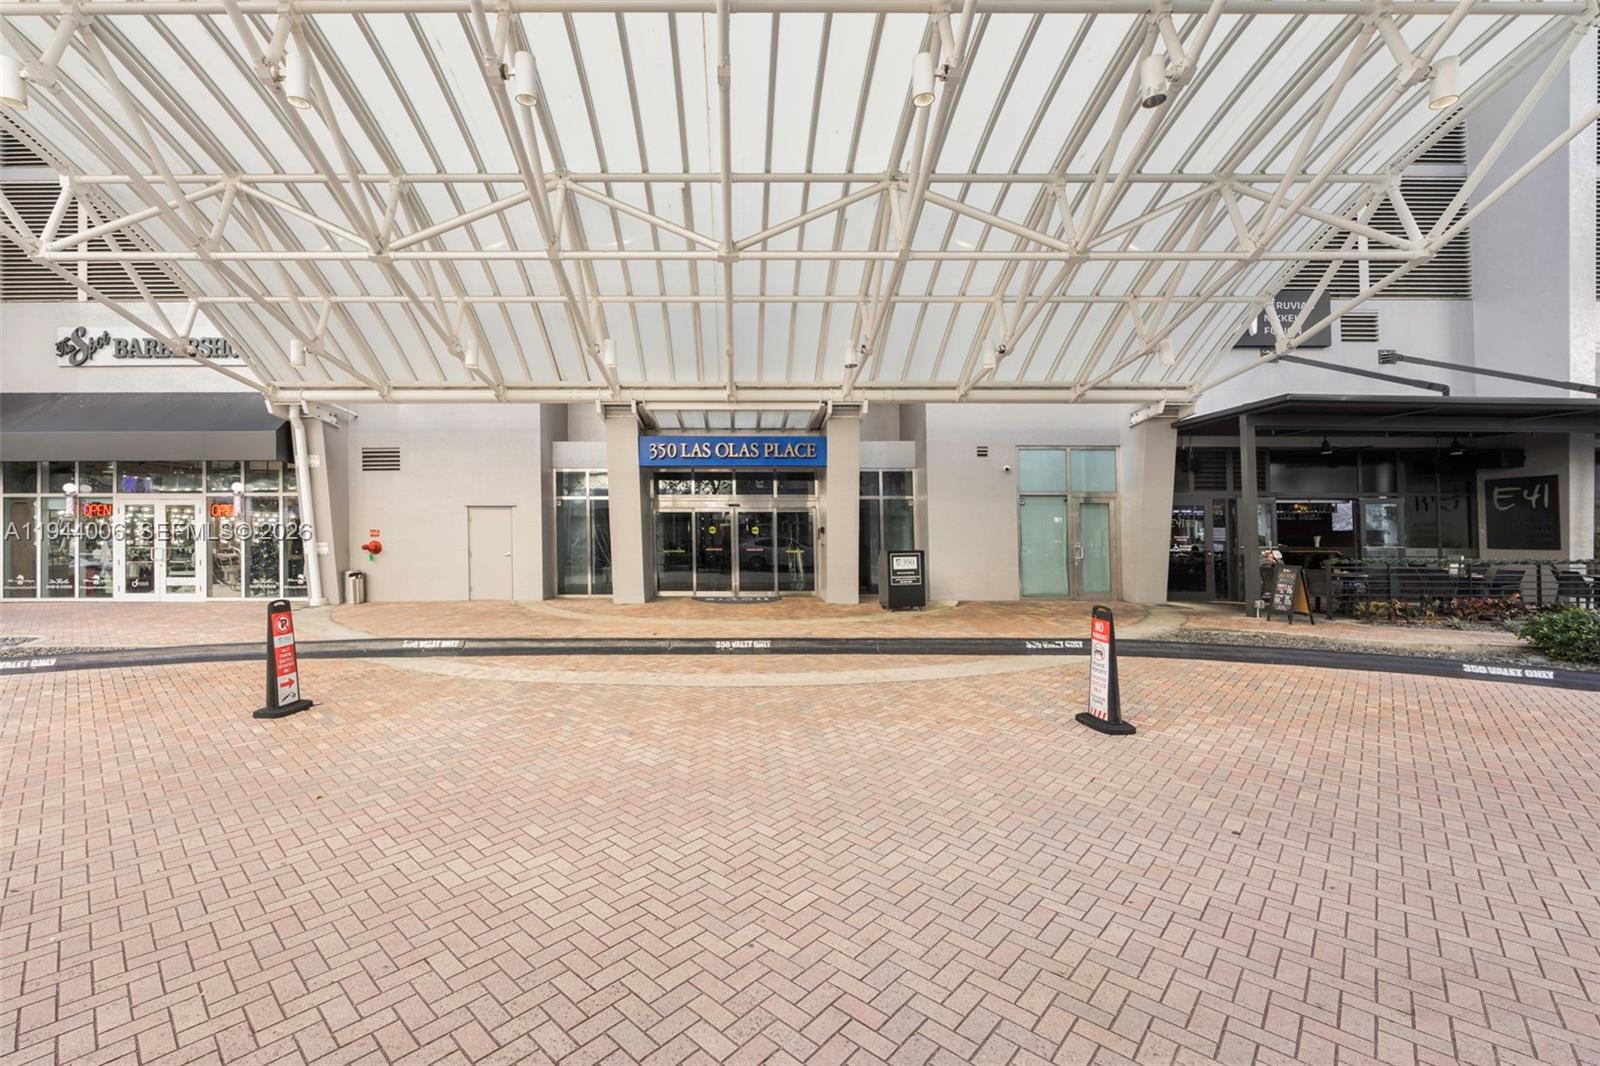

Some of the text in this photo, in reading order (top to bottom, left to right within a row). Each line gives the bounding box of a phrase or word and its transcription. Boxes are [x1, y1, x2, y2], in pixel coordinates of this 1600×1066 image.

[1272, 301, 1315, 310] RUVIA
[1263, 314, 1298, 322] NKEI
[1264, 326, 1303, 335] FUIN
[69, 326, 111, 366] Spot
[113, 337, 240, 358] BARBRSH
[650, 442, 817, 460] 350 LAS OLAS PLACE
[83, 503, 113, 517] OPEN
[211, 504, 236, 517] OPE
[1462, 663, 1554, 679] 350 VALET ONLY
